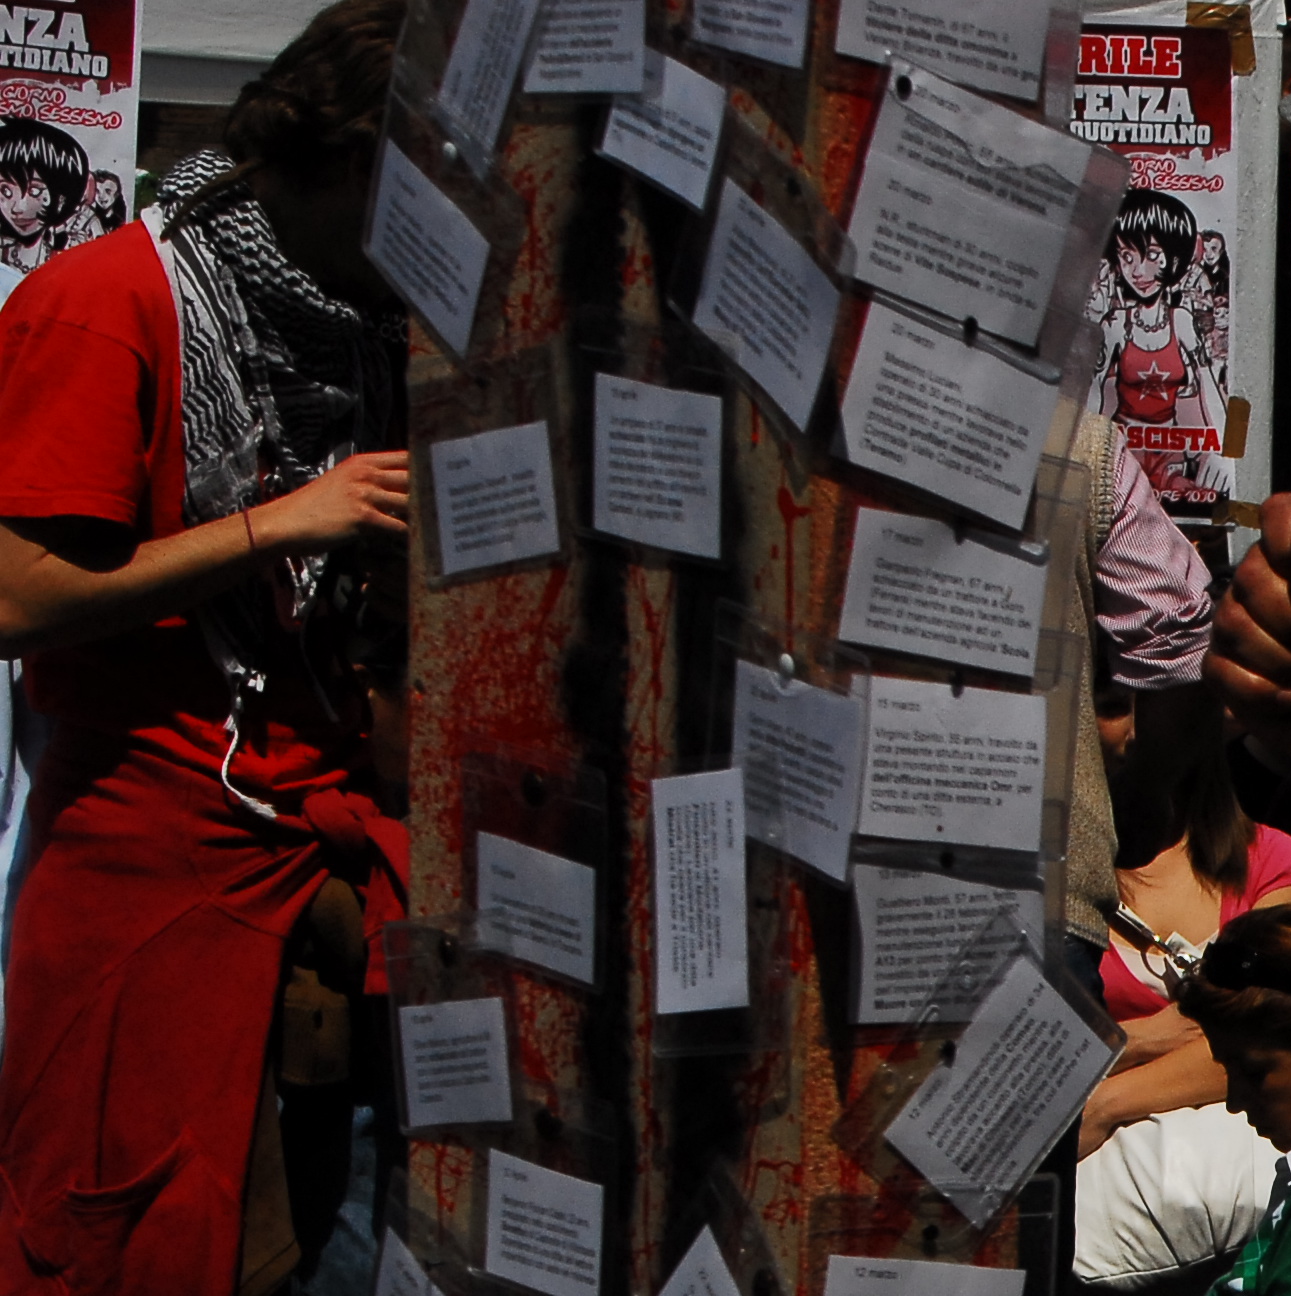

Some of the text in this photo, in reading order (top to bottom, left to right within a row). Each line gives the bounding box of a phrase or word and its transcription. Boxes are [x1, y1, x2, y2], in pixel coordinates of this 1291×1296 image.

[1077, 34, 1182, 79] RILE
[2, 85, 66, 105] GIORNO
[38, 105, 122, 130] SESSISMO
[1153, 174, 1224, 192] SESSISMO
